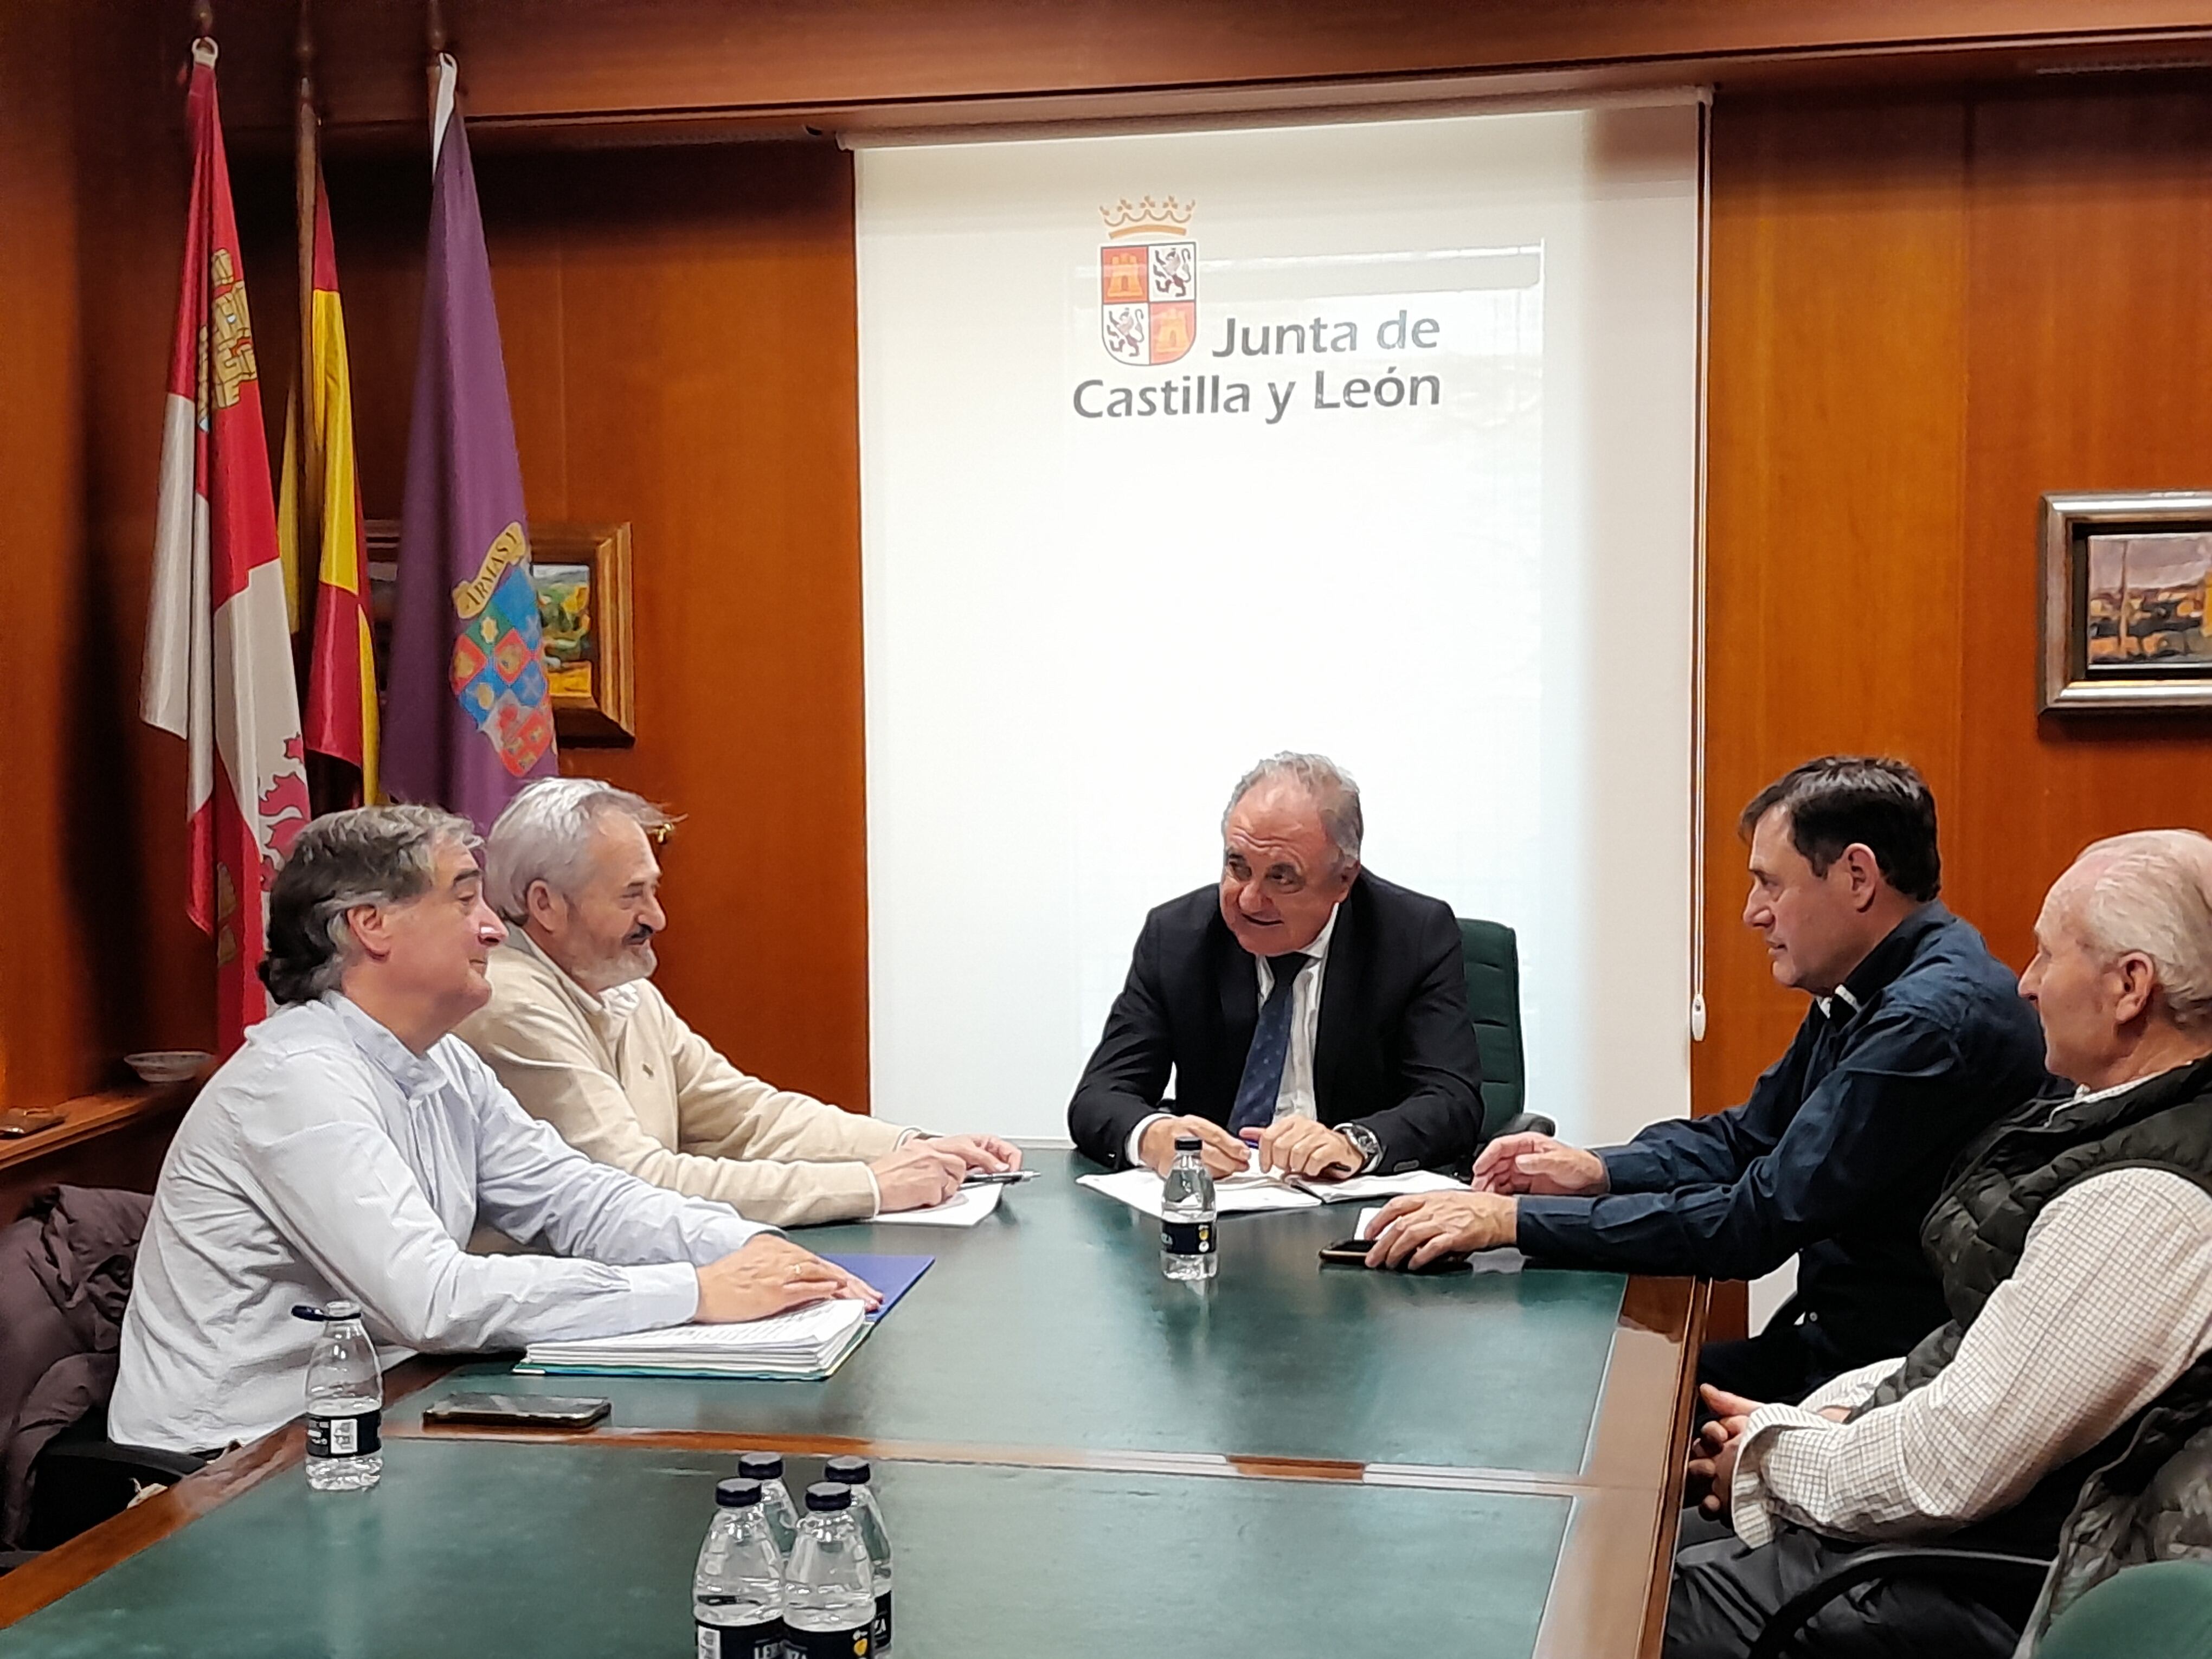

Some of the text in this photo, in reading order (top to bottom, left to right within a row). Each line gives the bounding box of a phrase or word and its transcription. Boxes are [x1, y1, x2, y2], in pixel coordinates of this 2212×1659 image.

[1212, 310, 1441, 358] Junta de
[1073, 366, 1441, 425] Castilla y León
